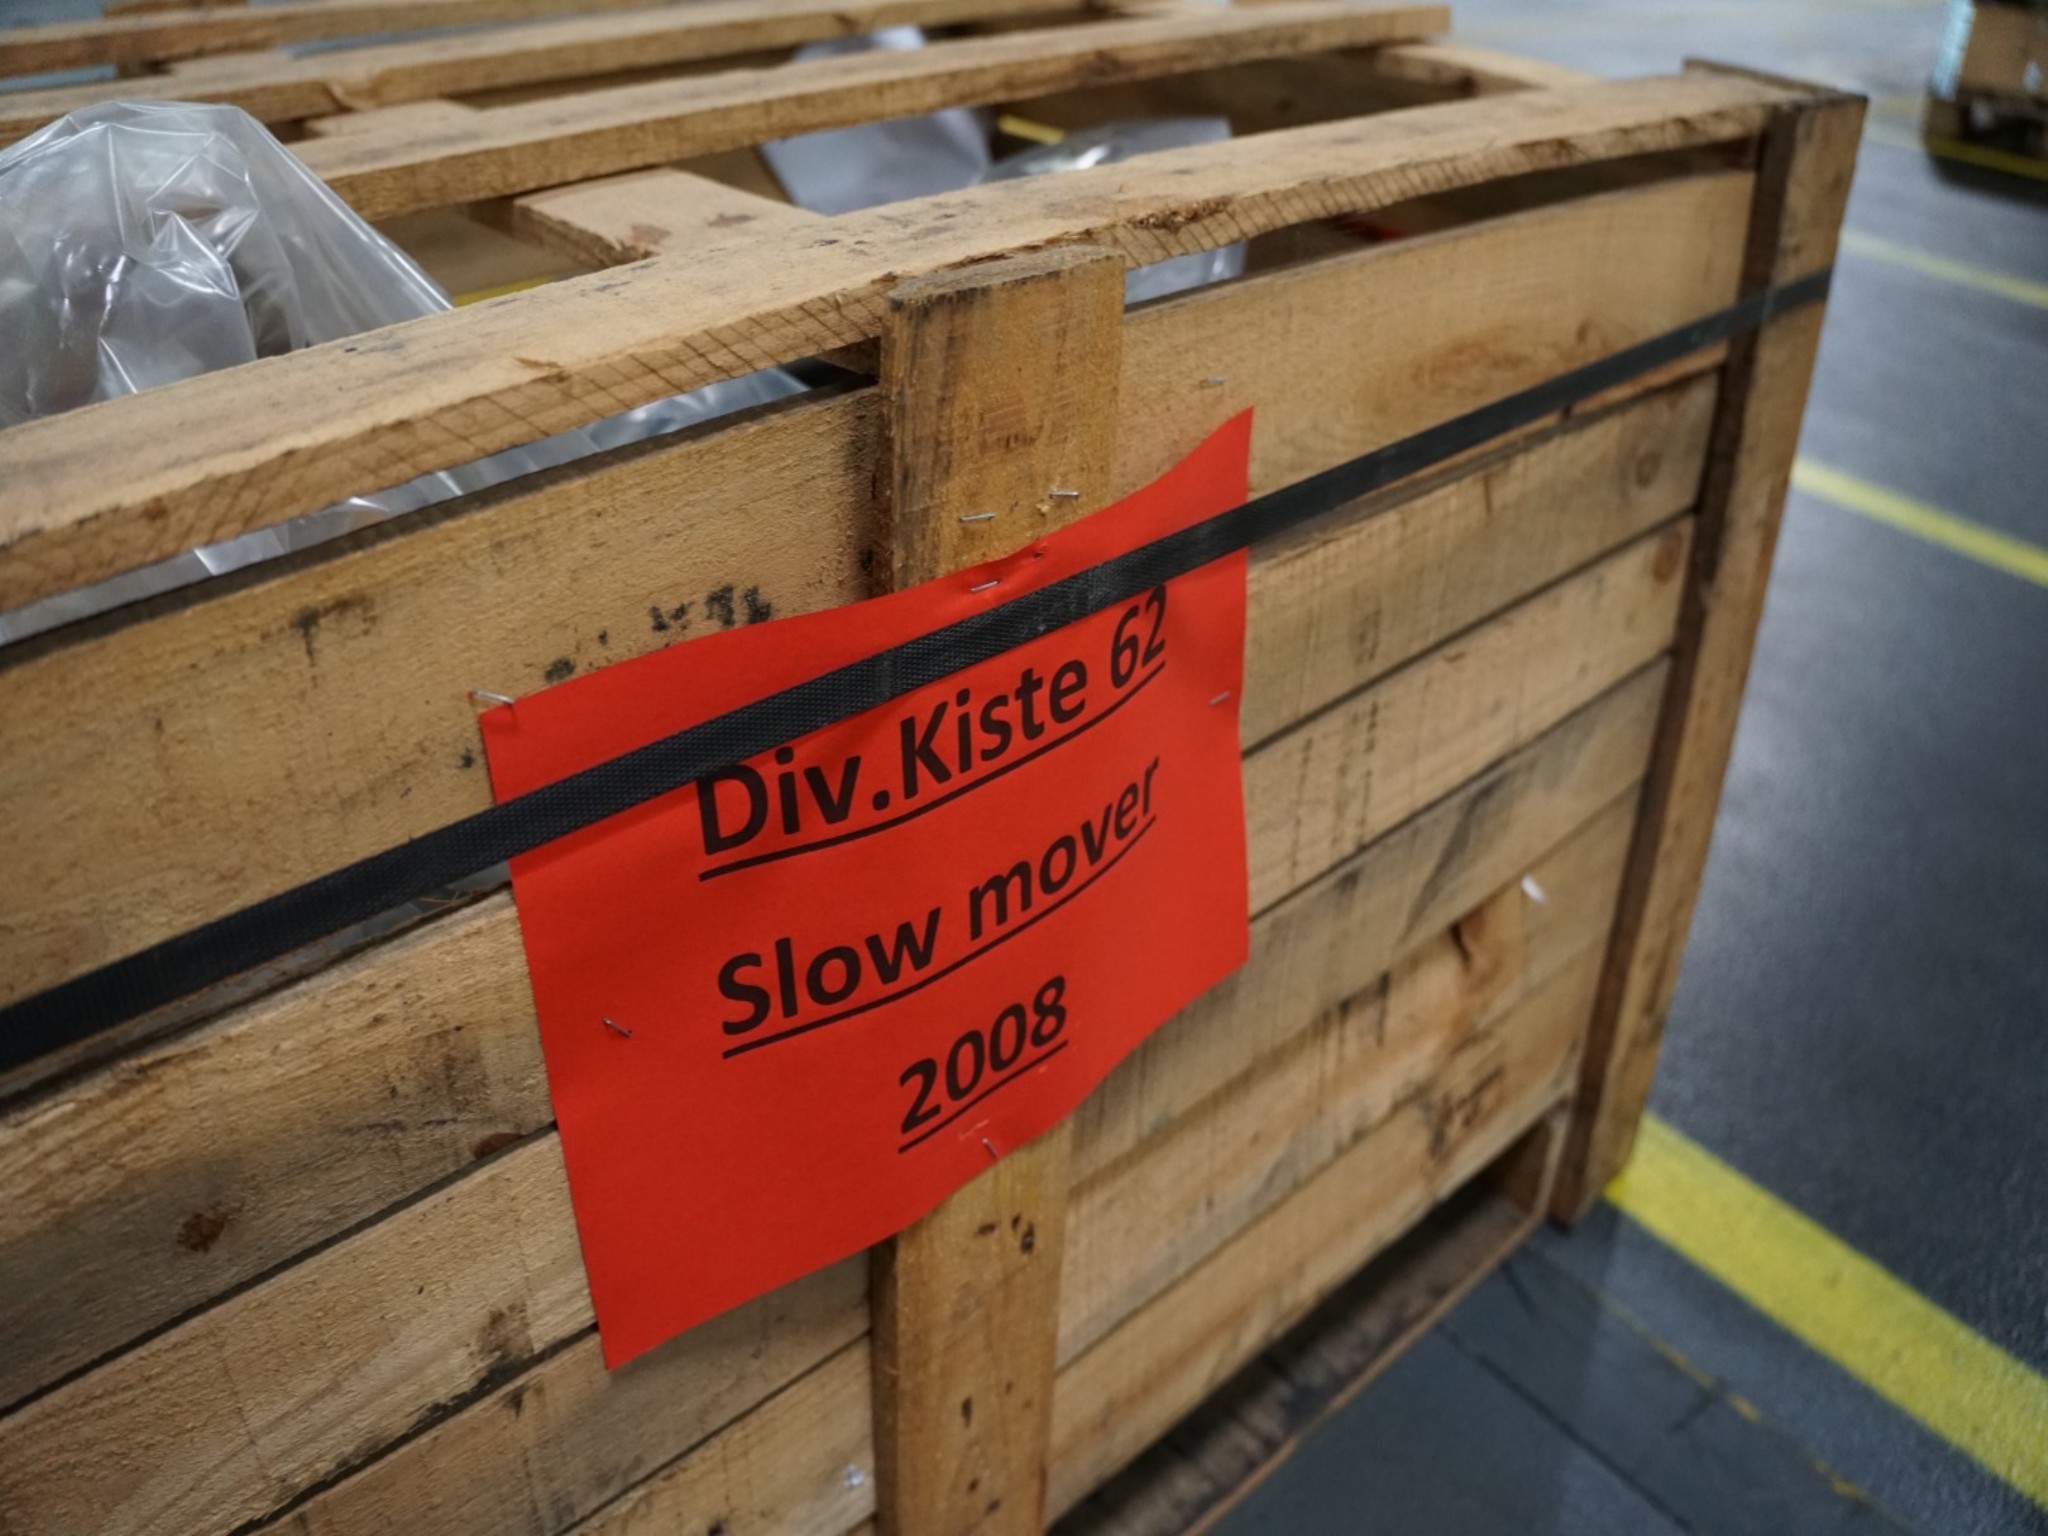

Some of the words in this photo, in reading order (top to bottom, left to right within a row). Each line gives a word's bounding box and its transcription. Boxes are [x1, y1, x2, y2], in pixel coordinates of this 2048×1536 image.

[697, 659, 1088, 855] Div.Kiste
[1110, 583, 1168, 689] 62
[717, 906, 942, 1036] Slow
[968, 756, 1160, 941] mover
[899, 975, 1068, 1135] 2008
